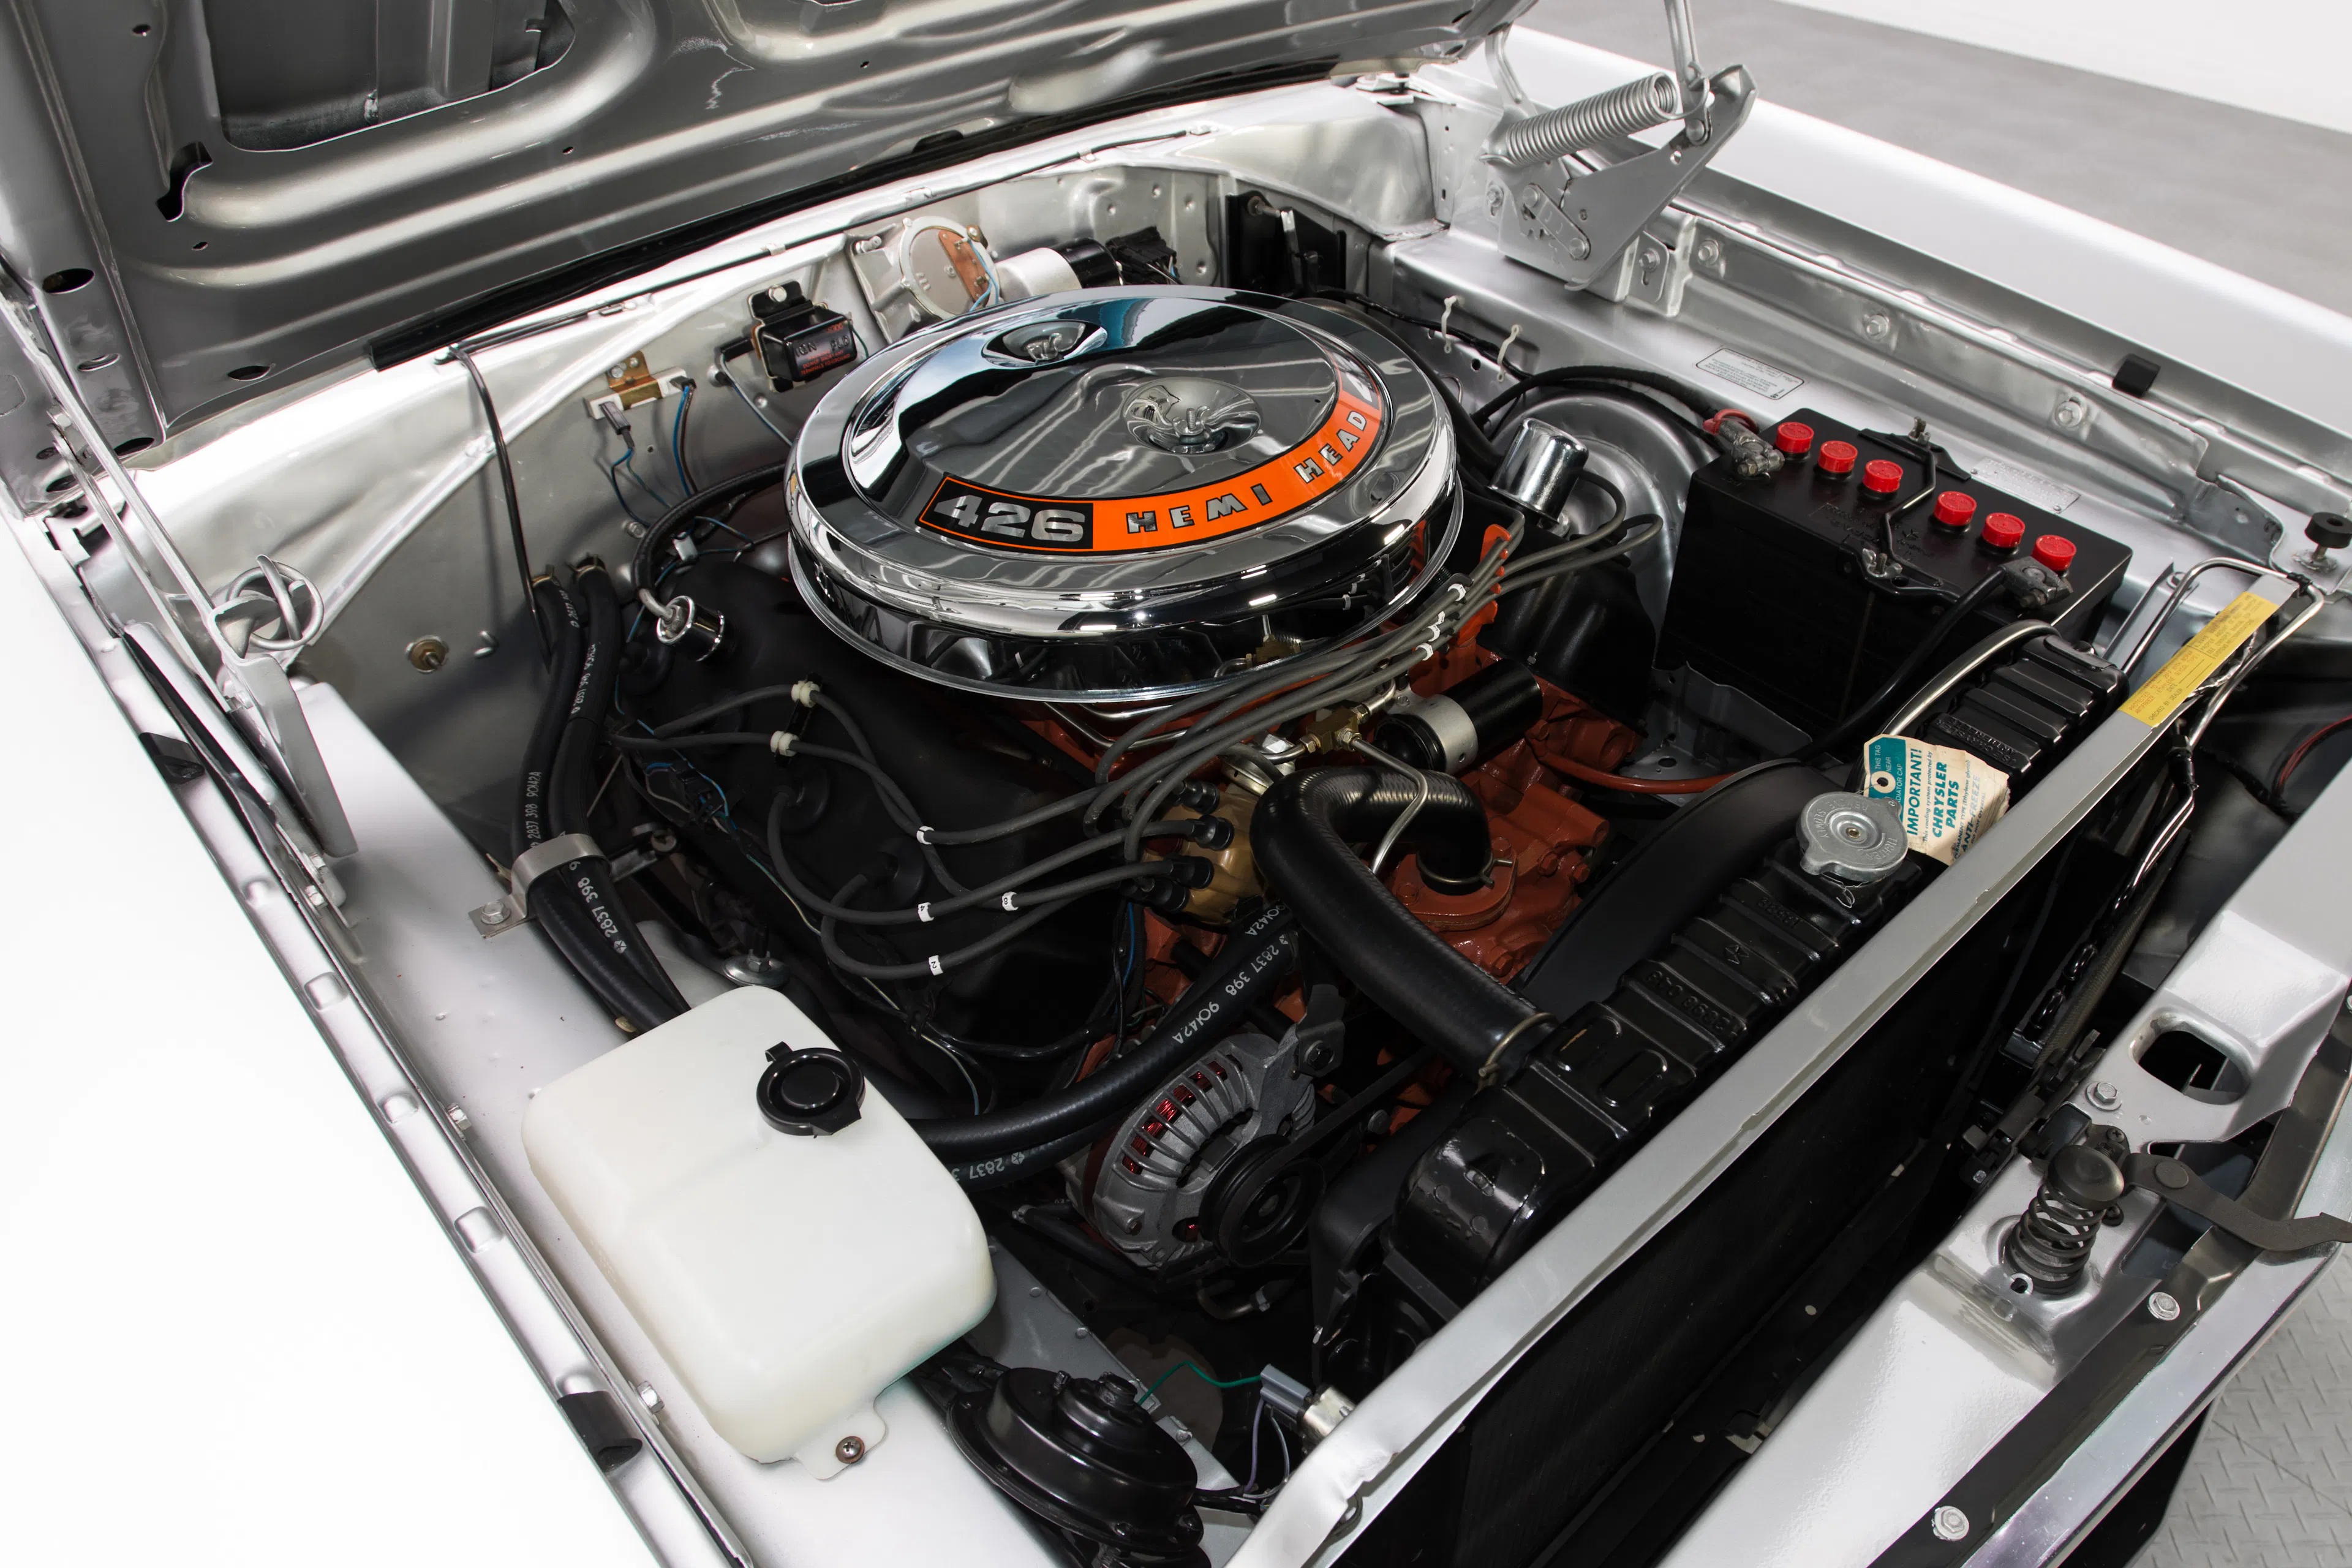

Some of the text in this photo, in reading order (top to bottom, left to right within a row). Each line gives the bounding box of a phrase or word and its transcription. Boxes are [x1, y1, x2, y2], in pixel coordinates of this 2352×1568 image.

[932, 410, 1367, 541] 426 HEMI HEAD
[1907, 748, 1921, 835] IMPORTANT!
[1932, 761, 1947, 837] CHRYSLER
[1946, 780, 1959, 828] PARTS
[525, 804, 538, 818] 398
[528, 820, 541, 839] 2837
[578, 877, 598, 903] 398
[592, 905, 618, 938] 2837
[1251, 944, 1279, 973] 2837
[1226, 971, 1250, 995] 398
[970, 1157, 1005, 1179] 2837
